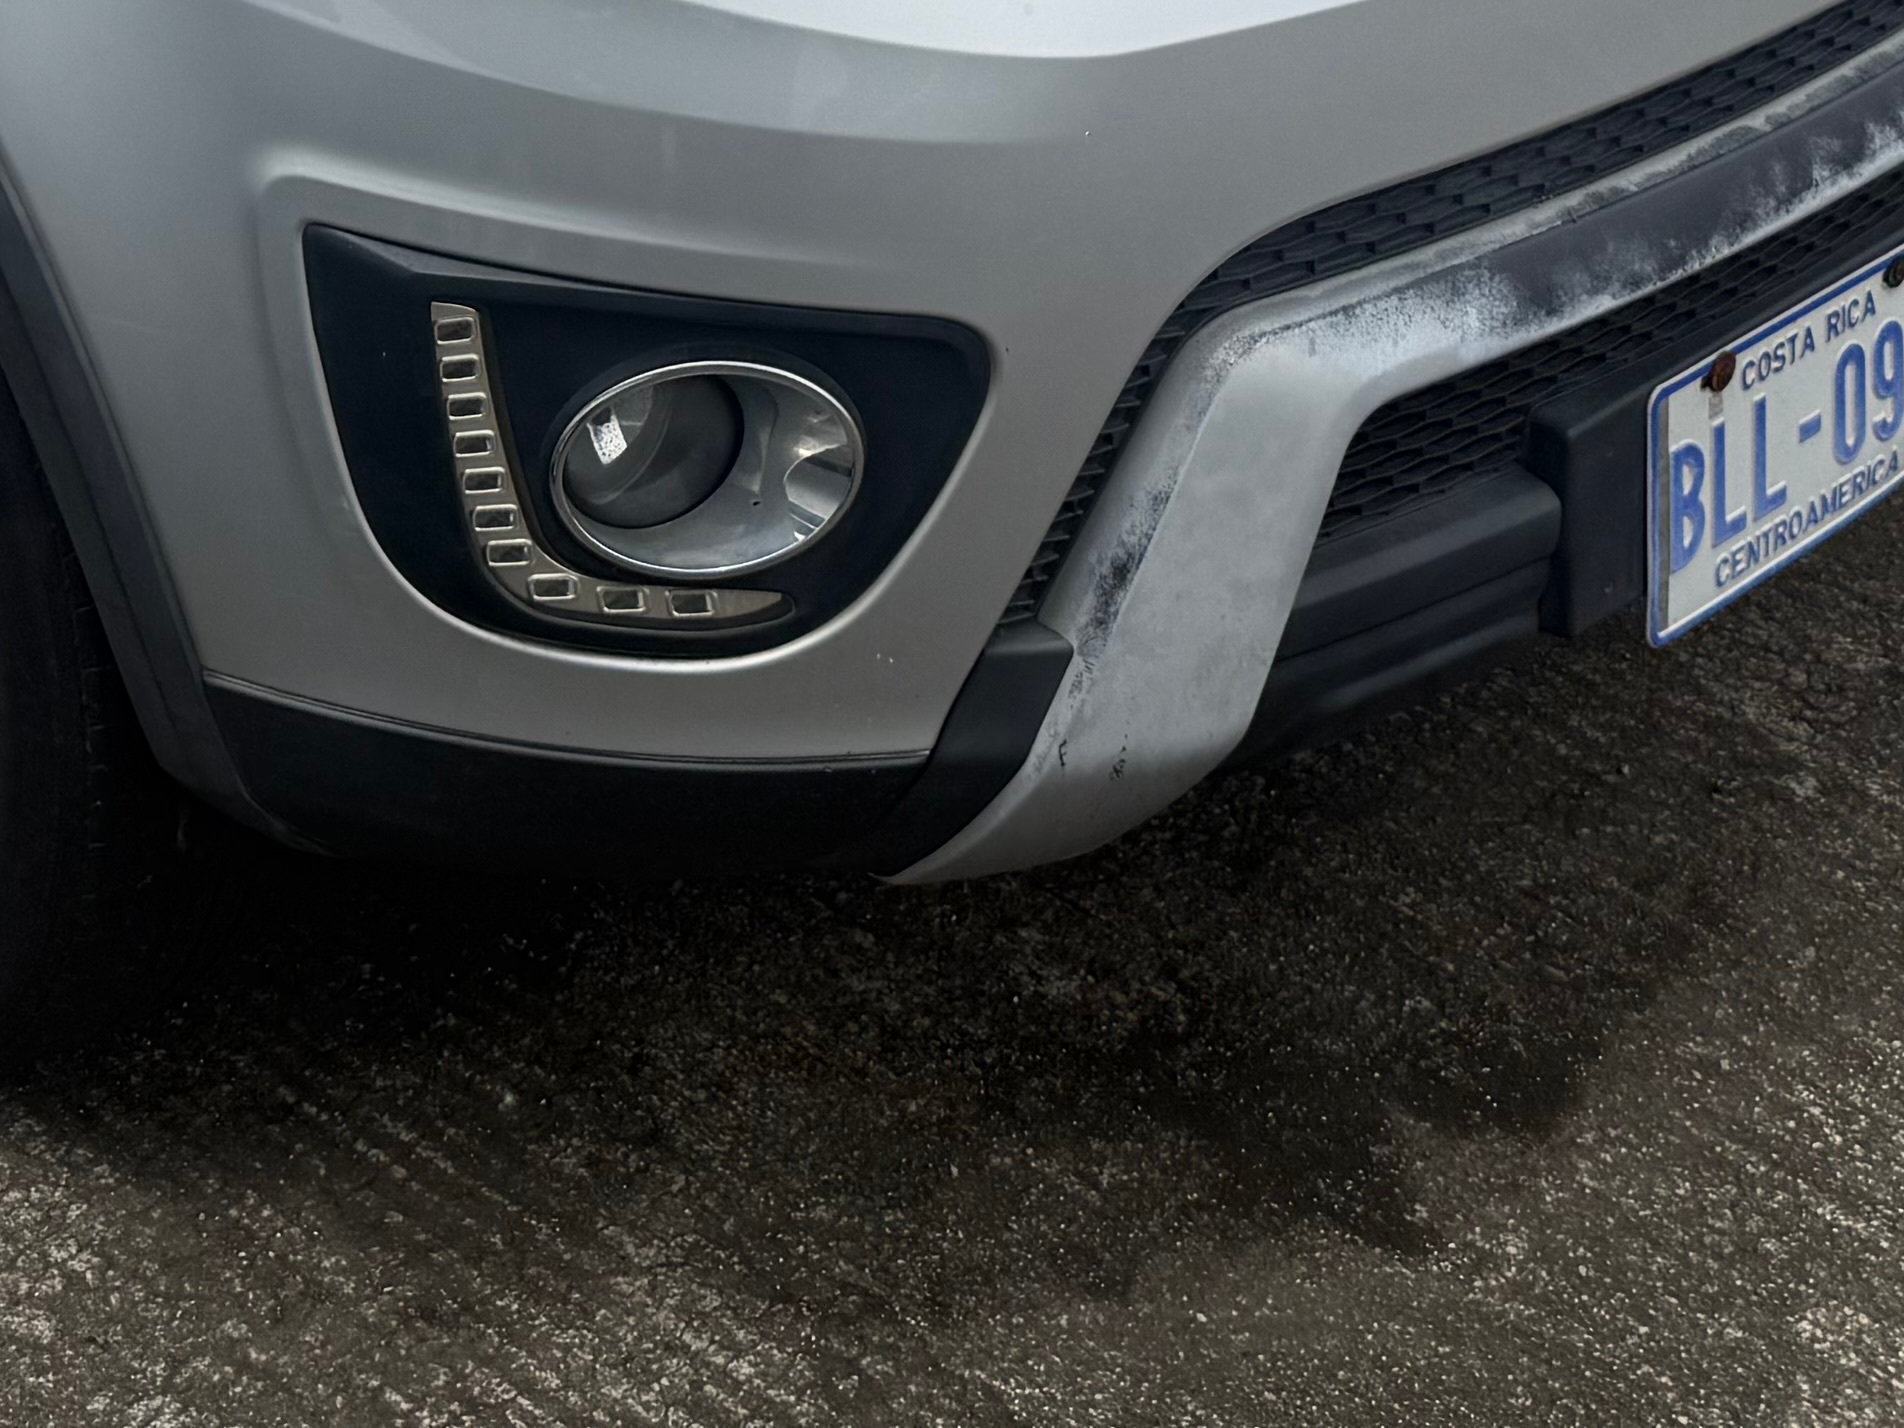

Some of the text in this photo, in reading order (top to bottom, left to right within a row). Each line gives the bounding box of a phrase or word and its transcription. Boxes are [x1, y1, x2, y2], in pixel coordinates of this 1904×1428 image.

[1741, 289, 1877, 392] COSTA RICA
[1714, 450, 1900, 588] CENTROAMERICA
